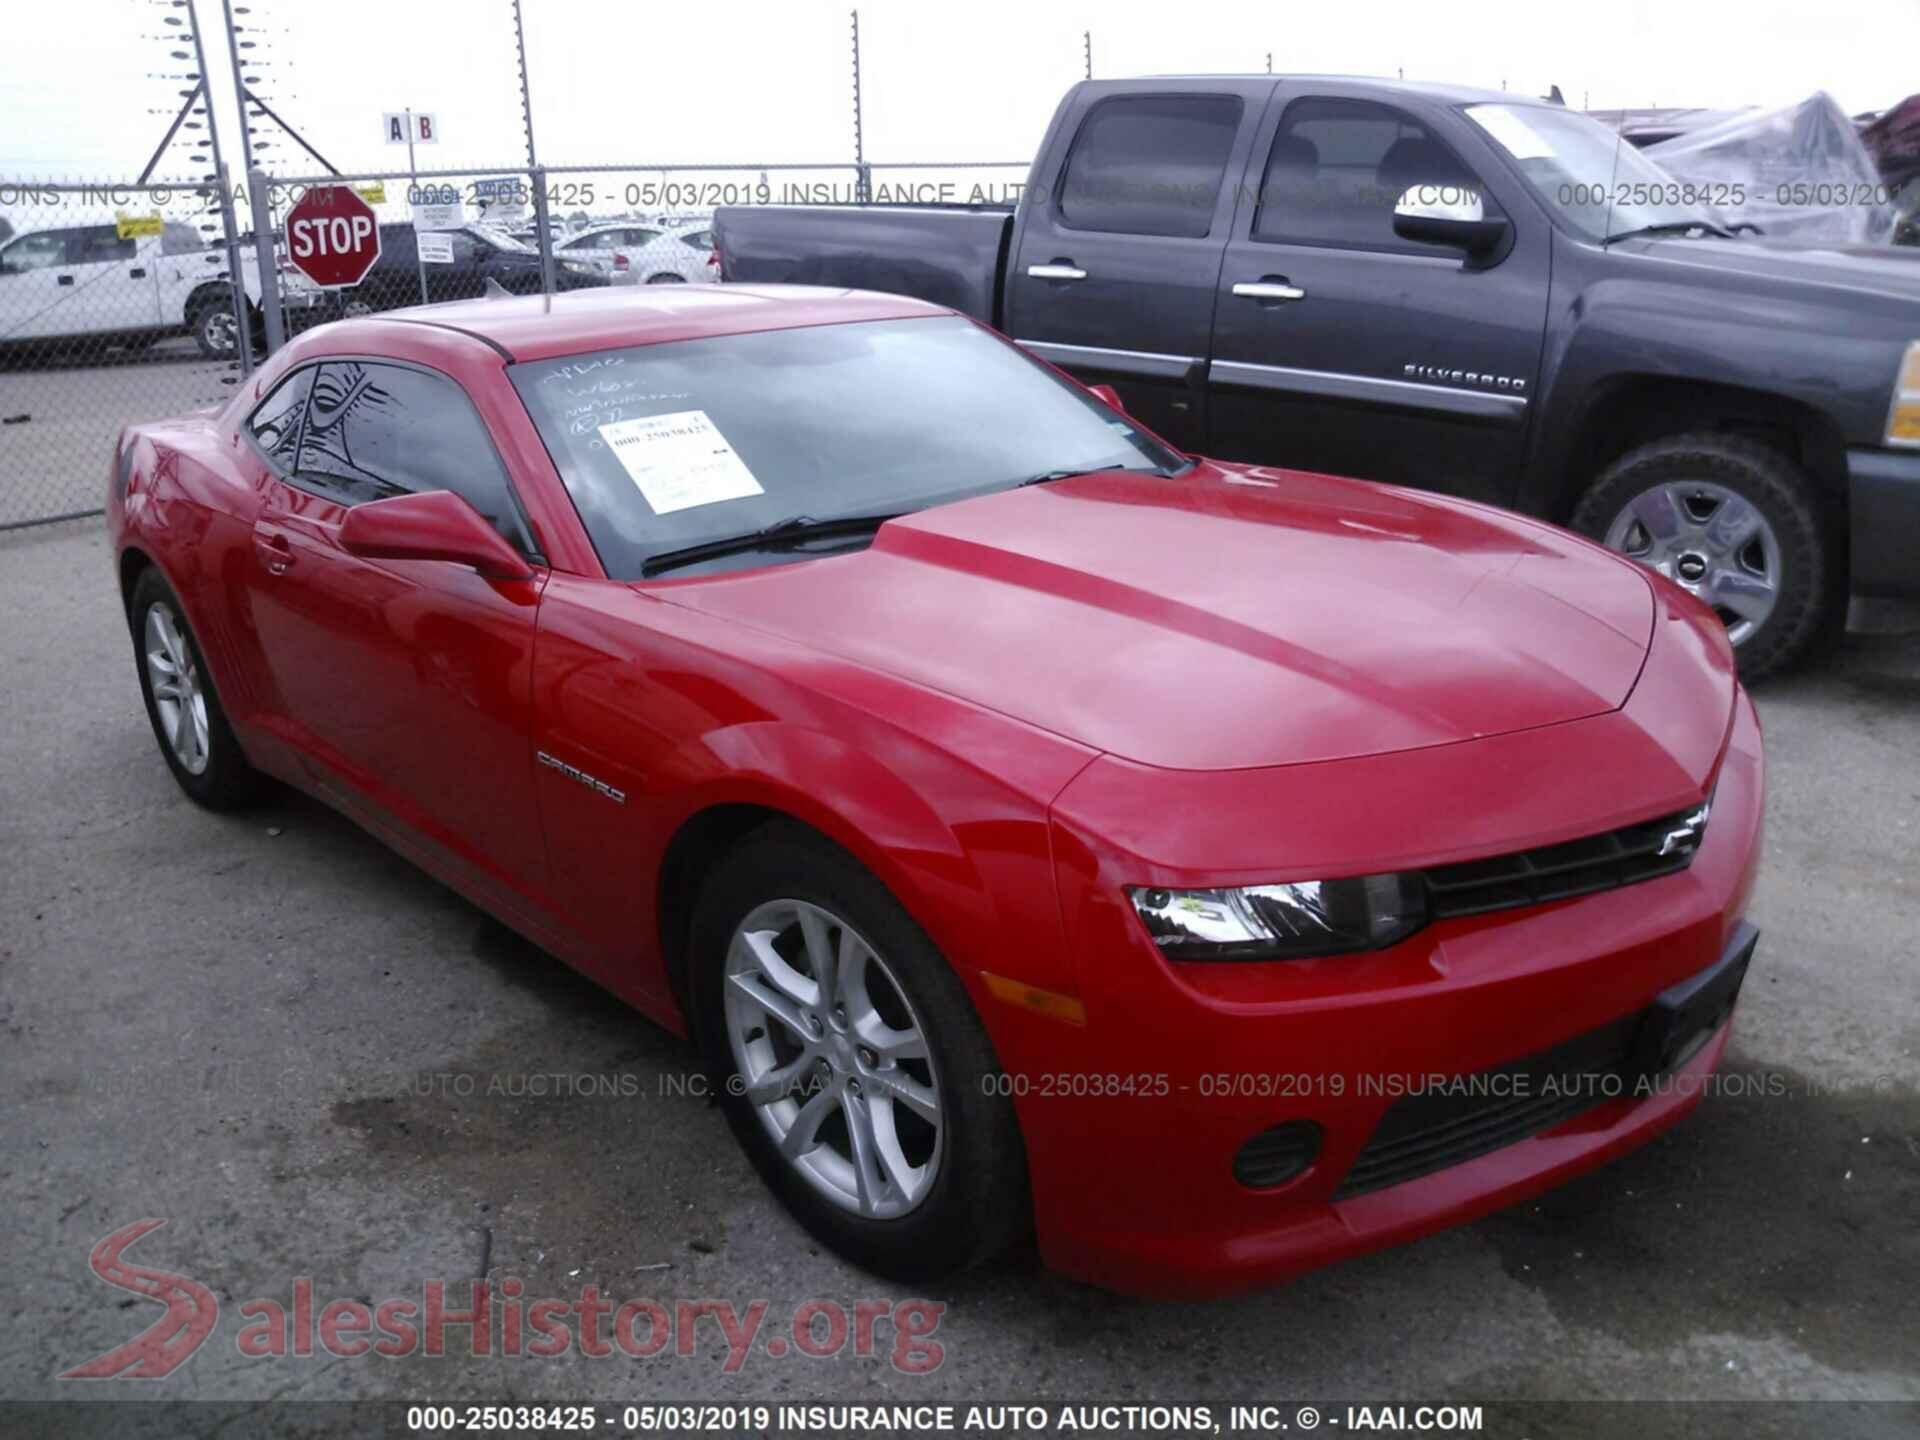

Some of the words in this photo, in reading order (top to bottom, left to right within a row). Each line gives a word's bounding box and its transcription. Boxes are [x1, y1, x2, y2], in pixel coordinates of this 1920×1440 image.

[390, 116, 403, 141] A
[419, 116, 432, 140] B
[292, 214, 373, 258] STOP
[1403, 363, 1526, 391] SILVERADO
[537, 750, 625, 803] CAMARO
